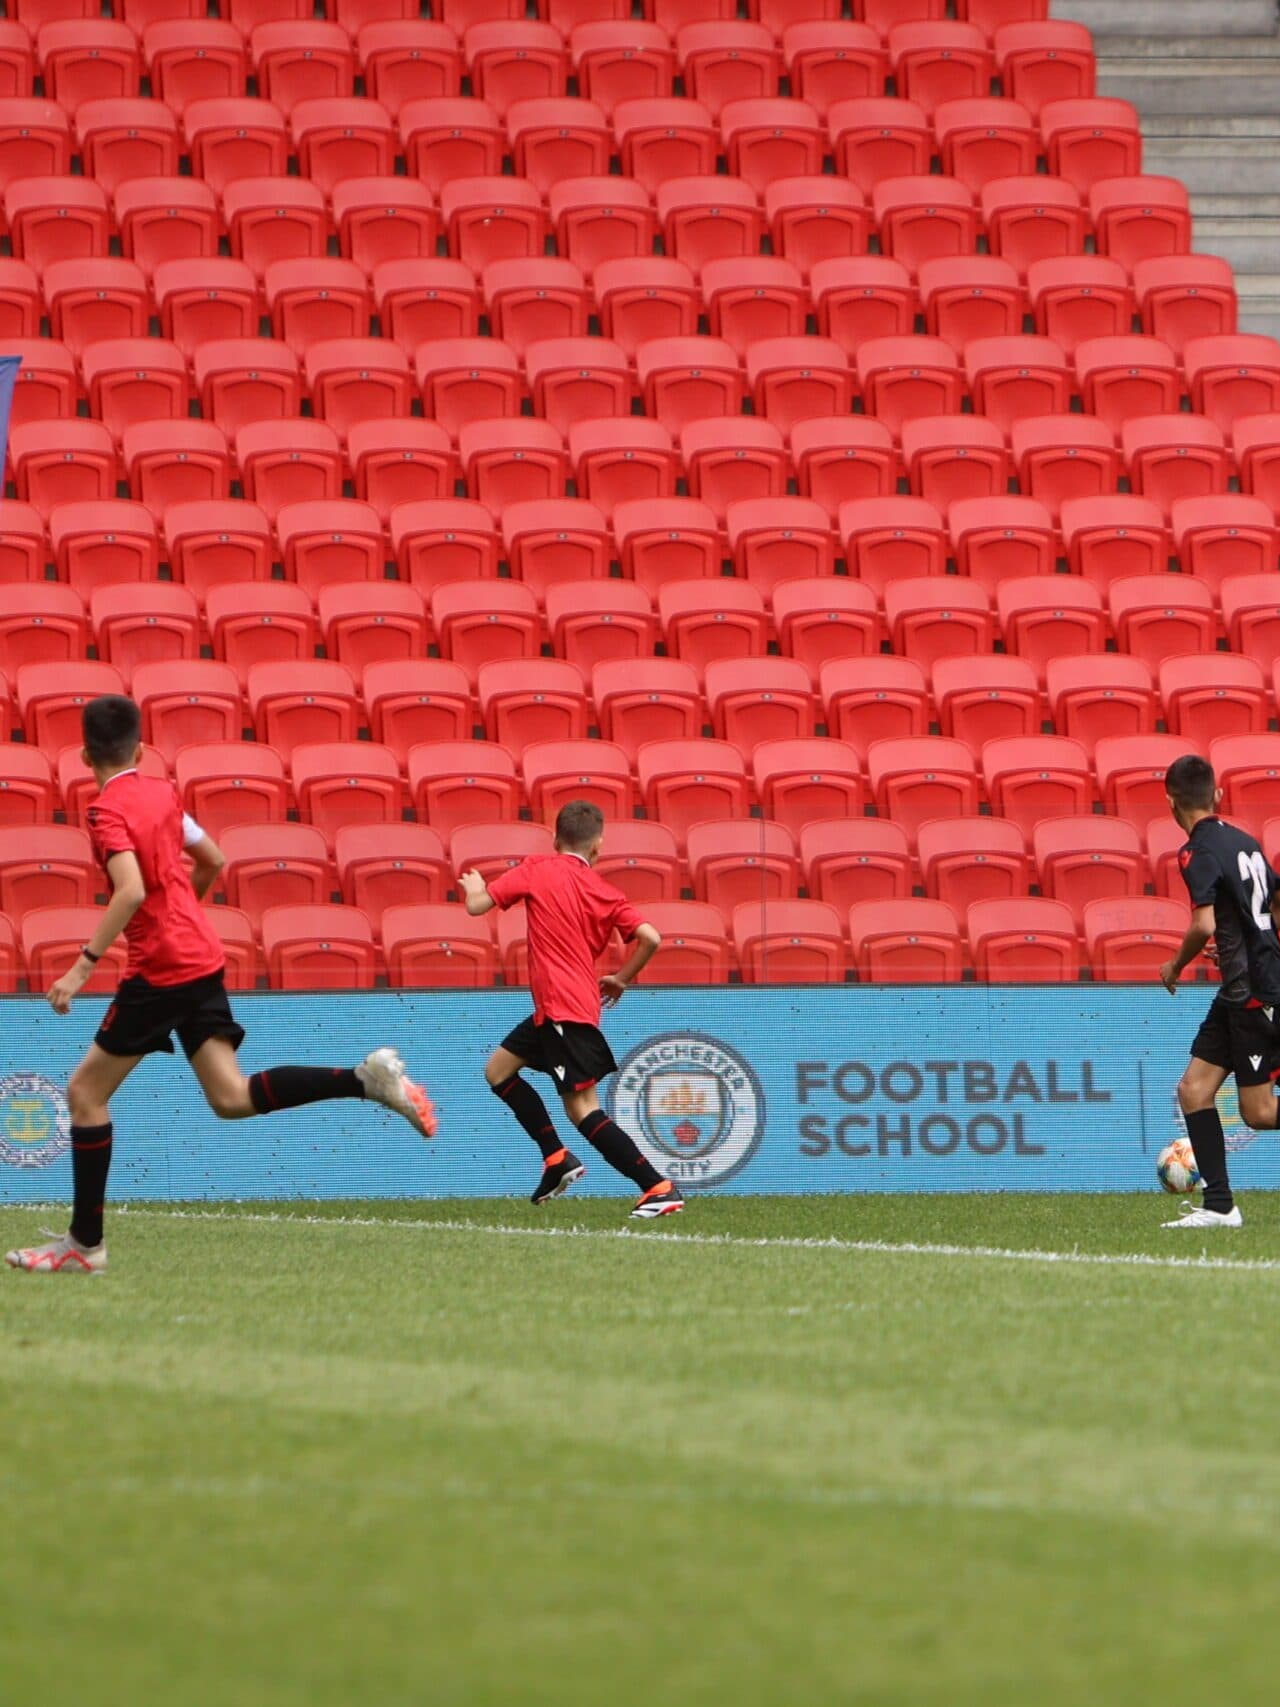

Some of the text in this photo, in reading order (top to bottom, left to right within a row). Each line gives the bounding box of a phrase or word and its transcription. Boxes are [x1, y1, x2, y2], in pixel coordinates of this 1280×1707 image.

[623, 1043, 746, 1092] MANCHESTER
[794, 1059, 1113, 1105] FOOTBALL
[797, 1111, 1046, 1158] SCHOOL
[664, 1159, 712, 1178] CITY
